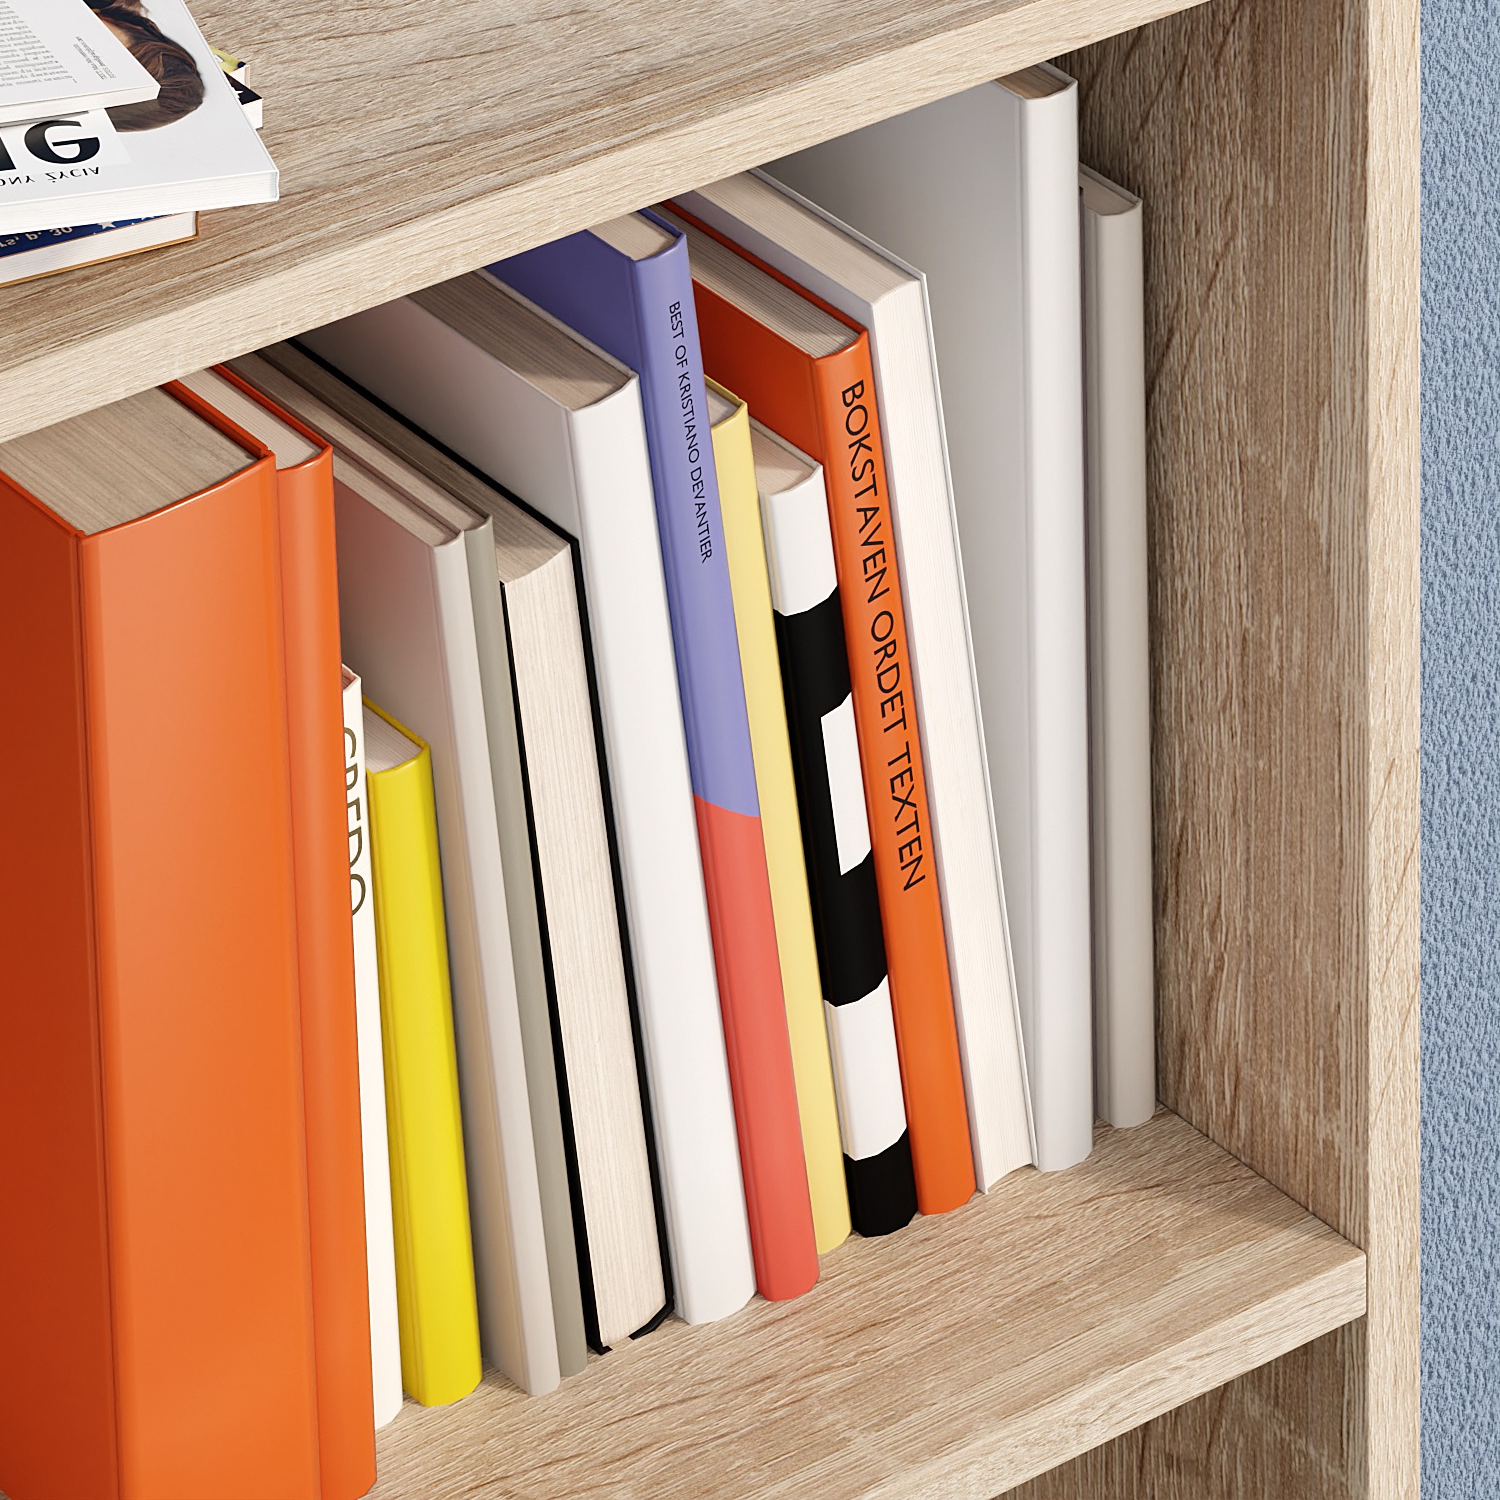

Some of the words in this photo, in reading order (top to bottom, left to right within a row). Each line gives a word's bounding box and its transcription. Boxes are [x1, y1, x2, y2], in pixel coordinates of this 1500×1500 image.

[669, 300, 685, 339] BEST
[674, 344, 689, 366] OF
[678, 372, 700, 464] KRISTIANO
[690, 466, 712, 564] DEVANTIER
[841, 379, 891, 604] BOKSTAVEN
[870, 610, 907, 735] ORDET
[886, 741, 928, 892] TEXTEN
